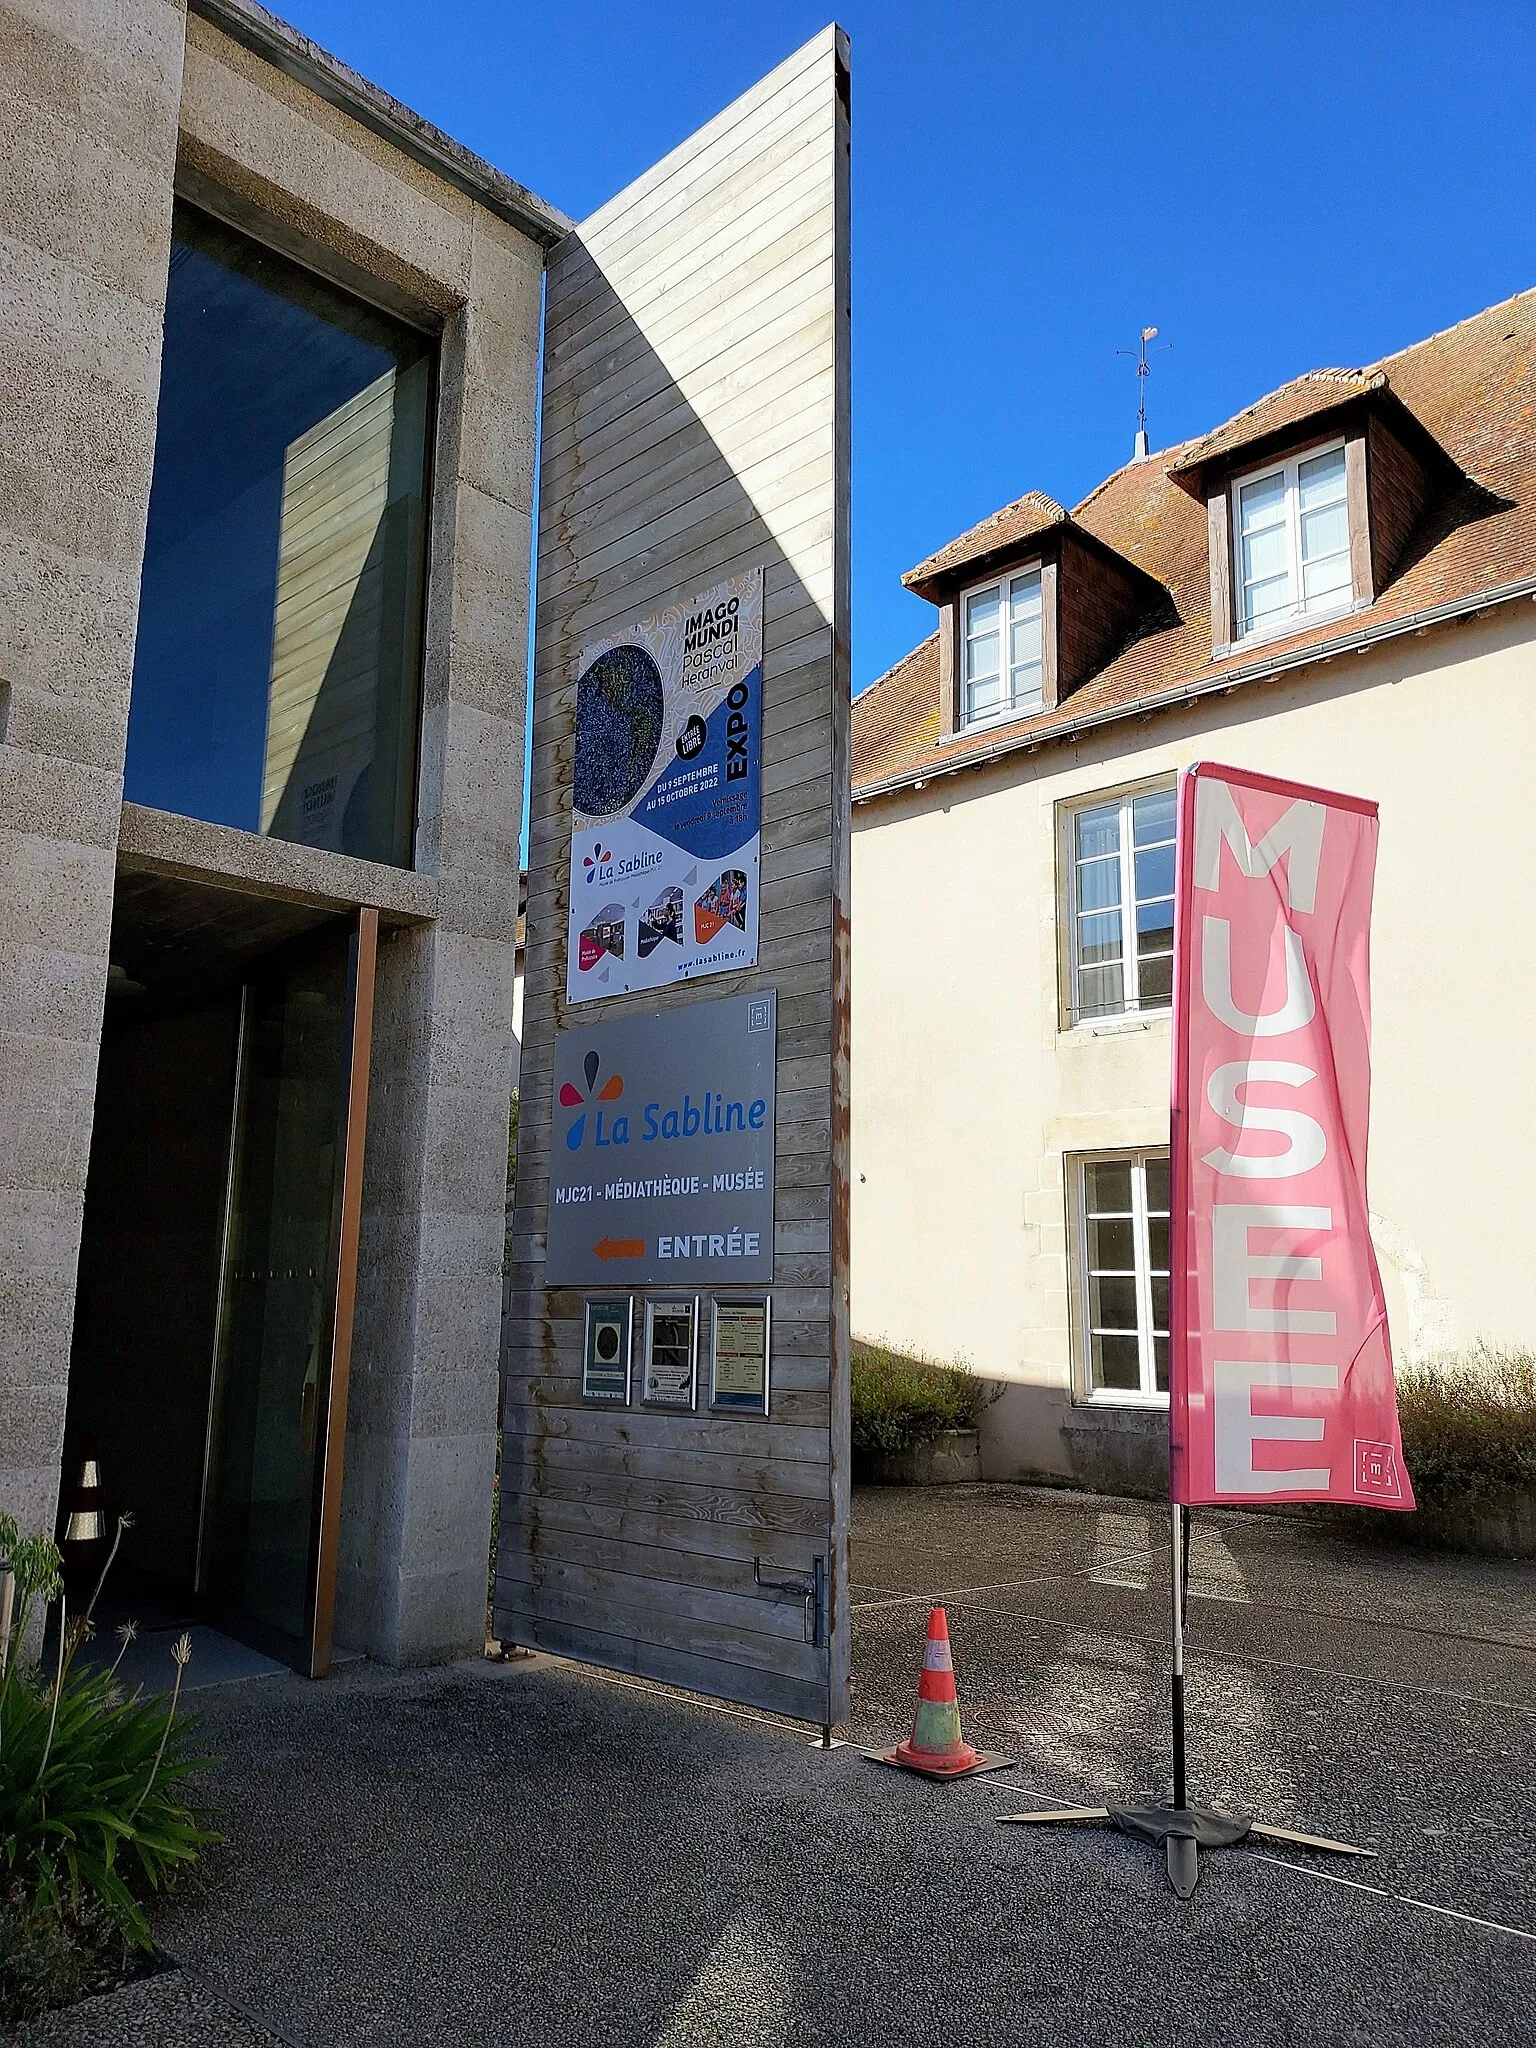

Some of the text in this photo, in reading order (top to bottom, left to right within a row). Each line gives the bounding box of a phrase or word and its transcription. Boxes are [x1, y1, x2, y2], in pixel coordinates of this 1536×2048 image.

[685, 597, 740, 636] IMAGO
[684, 615, 738, 654] MUNDI
[682, 634, 737, 673] Pascal
[681, 655, 737, 688] Heranval
[681, 725, 700, 744] ENTRÉE
[682, 736, 702, 755] LIBRE
[727, 683, 748, 782] EXPO
[646, 777, 719, 811] AU 15 OCTOBRE 2022
[657, 763, 719, 793] DU 9 SEPTEMBRE
[680, 815, 706, 829] vendredi
[712, 802, 748, 819] septembre
[712, 791, 748, 807] Vernissage
[735, 813, 748, 823] 18h
[599, 865, 614, 880] La
[617, 851, 663, 875] Sabline
[677, 948, 746, 970] www.lasabline.fr
[595, 1092, 767, 1147] La Sabline
[1195, 777, 1339, 1494] MUSEE
[555, 1185, 593, 1204] MJC21
[604, 1173, 700, 1201] MÉDIATHÈQUE
[712, 1167, 764, 1192] MUSÉE
[658, 1226, 761, 1259] ENTRÉE
